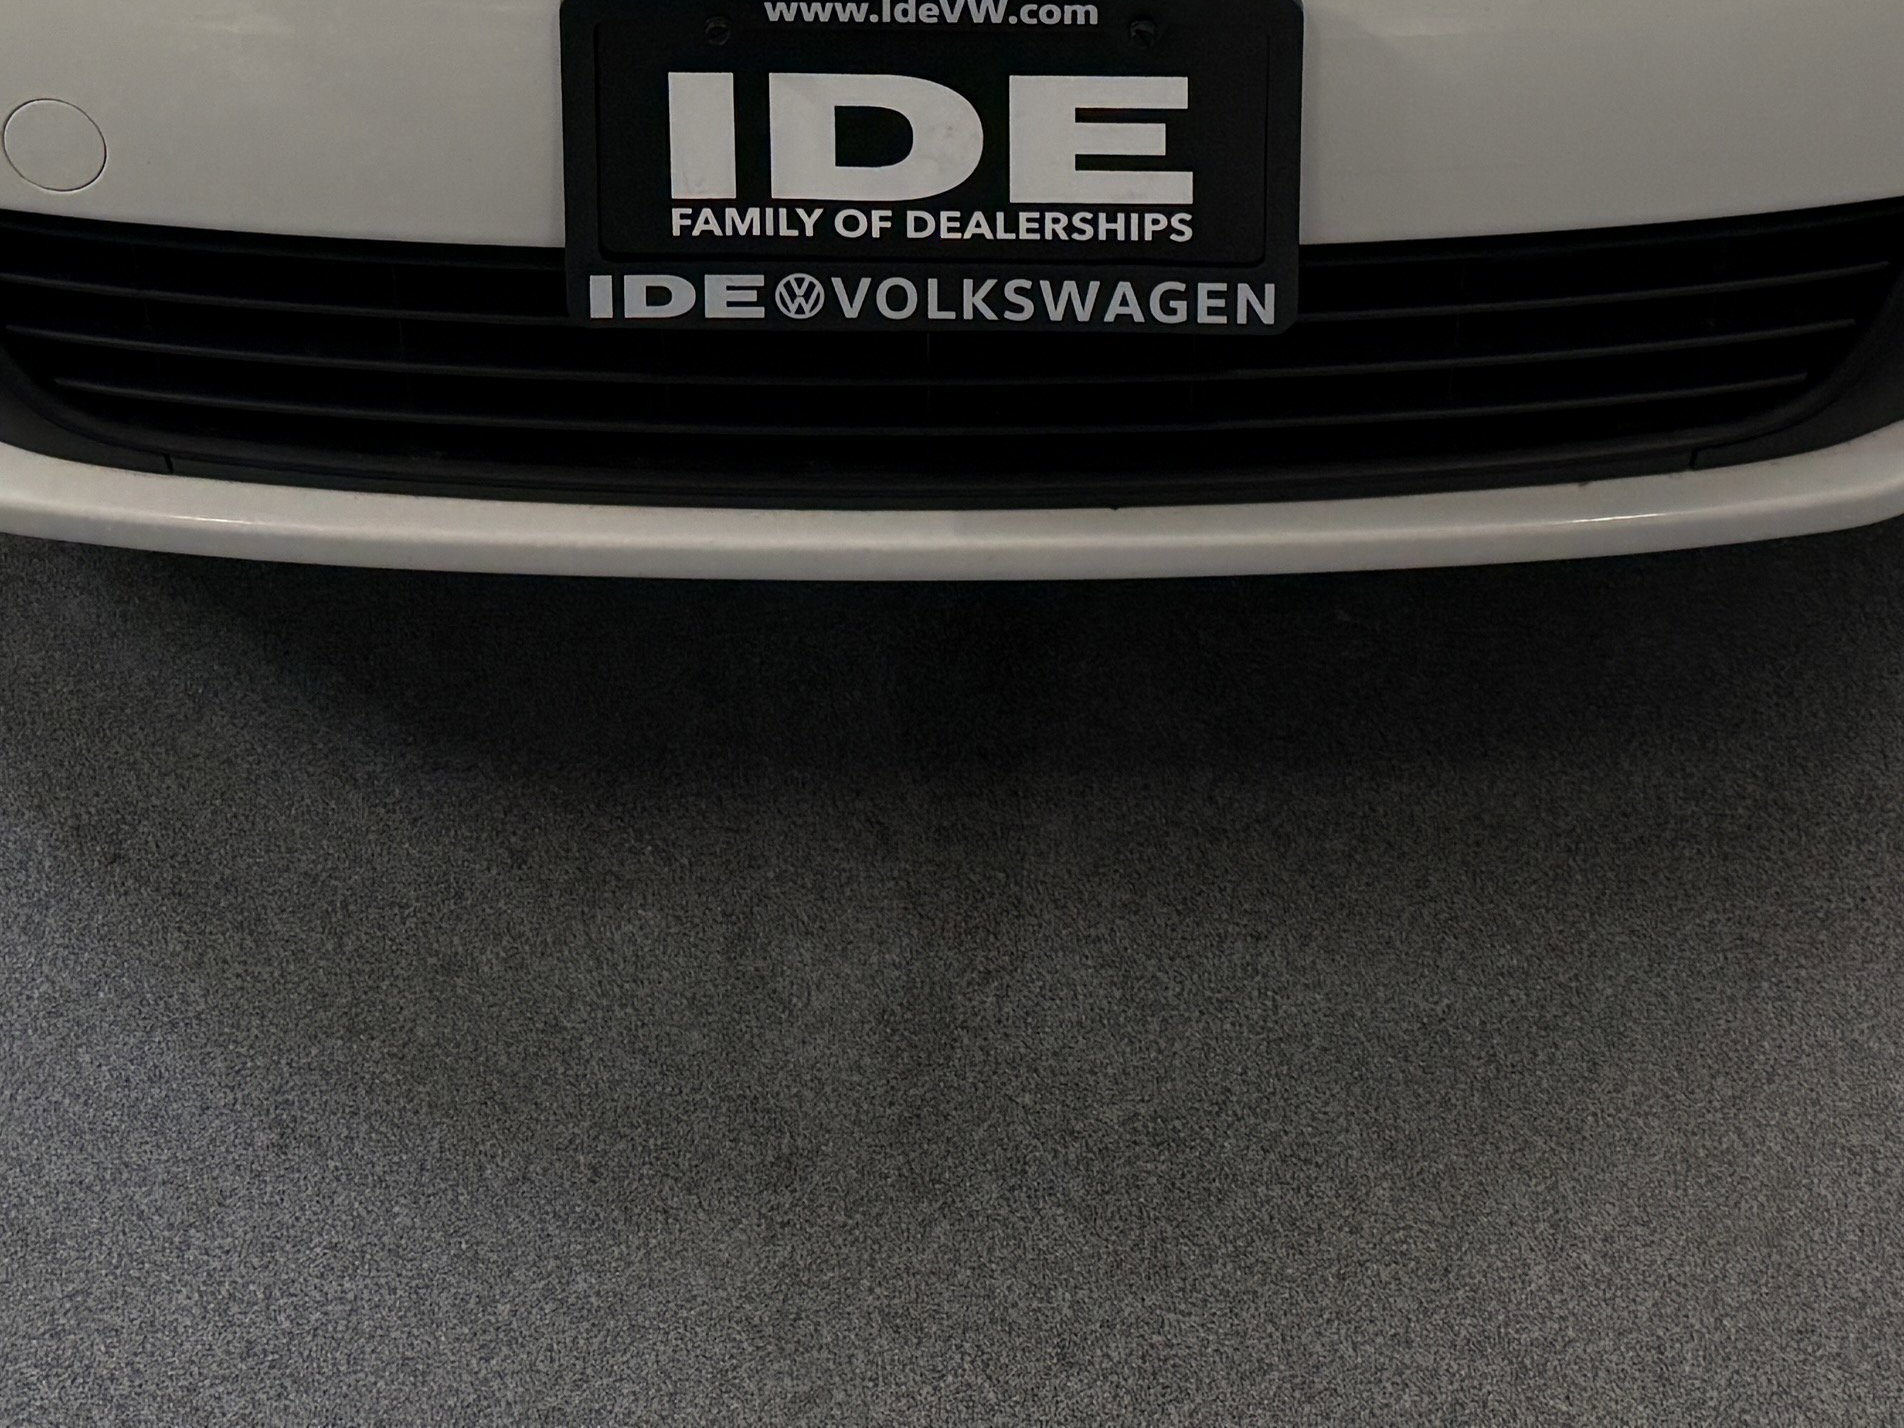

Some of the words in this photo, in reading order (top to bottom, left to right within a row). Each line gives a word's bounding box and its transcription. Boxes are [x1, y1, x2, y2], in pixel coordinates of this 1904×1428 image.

[667, 71, 1194, 205] IDE
[671, 207, 824, 238] FAMILY
[834, 208, 893, 239] OF
[906, 209, 1194, 243] DEALERSHIPS
[589, 274, 765, 320] IDE
[831, 276, 1276, 325] VOLKSWAGEN
